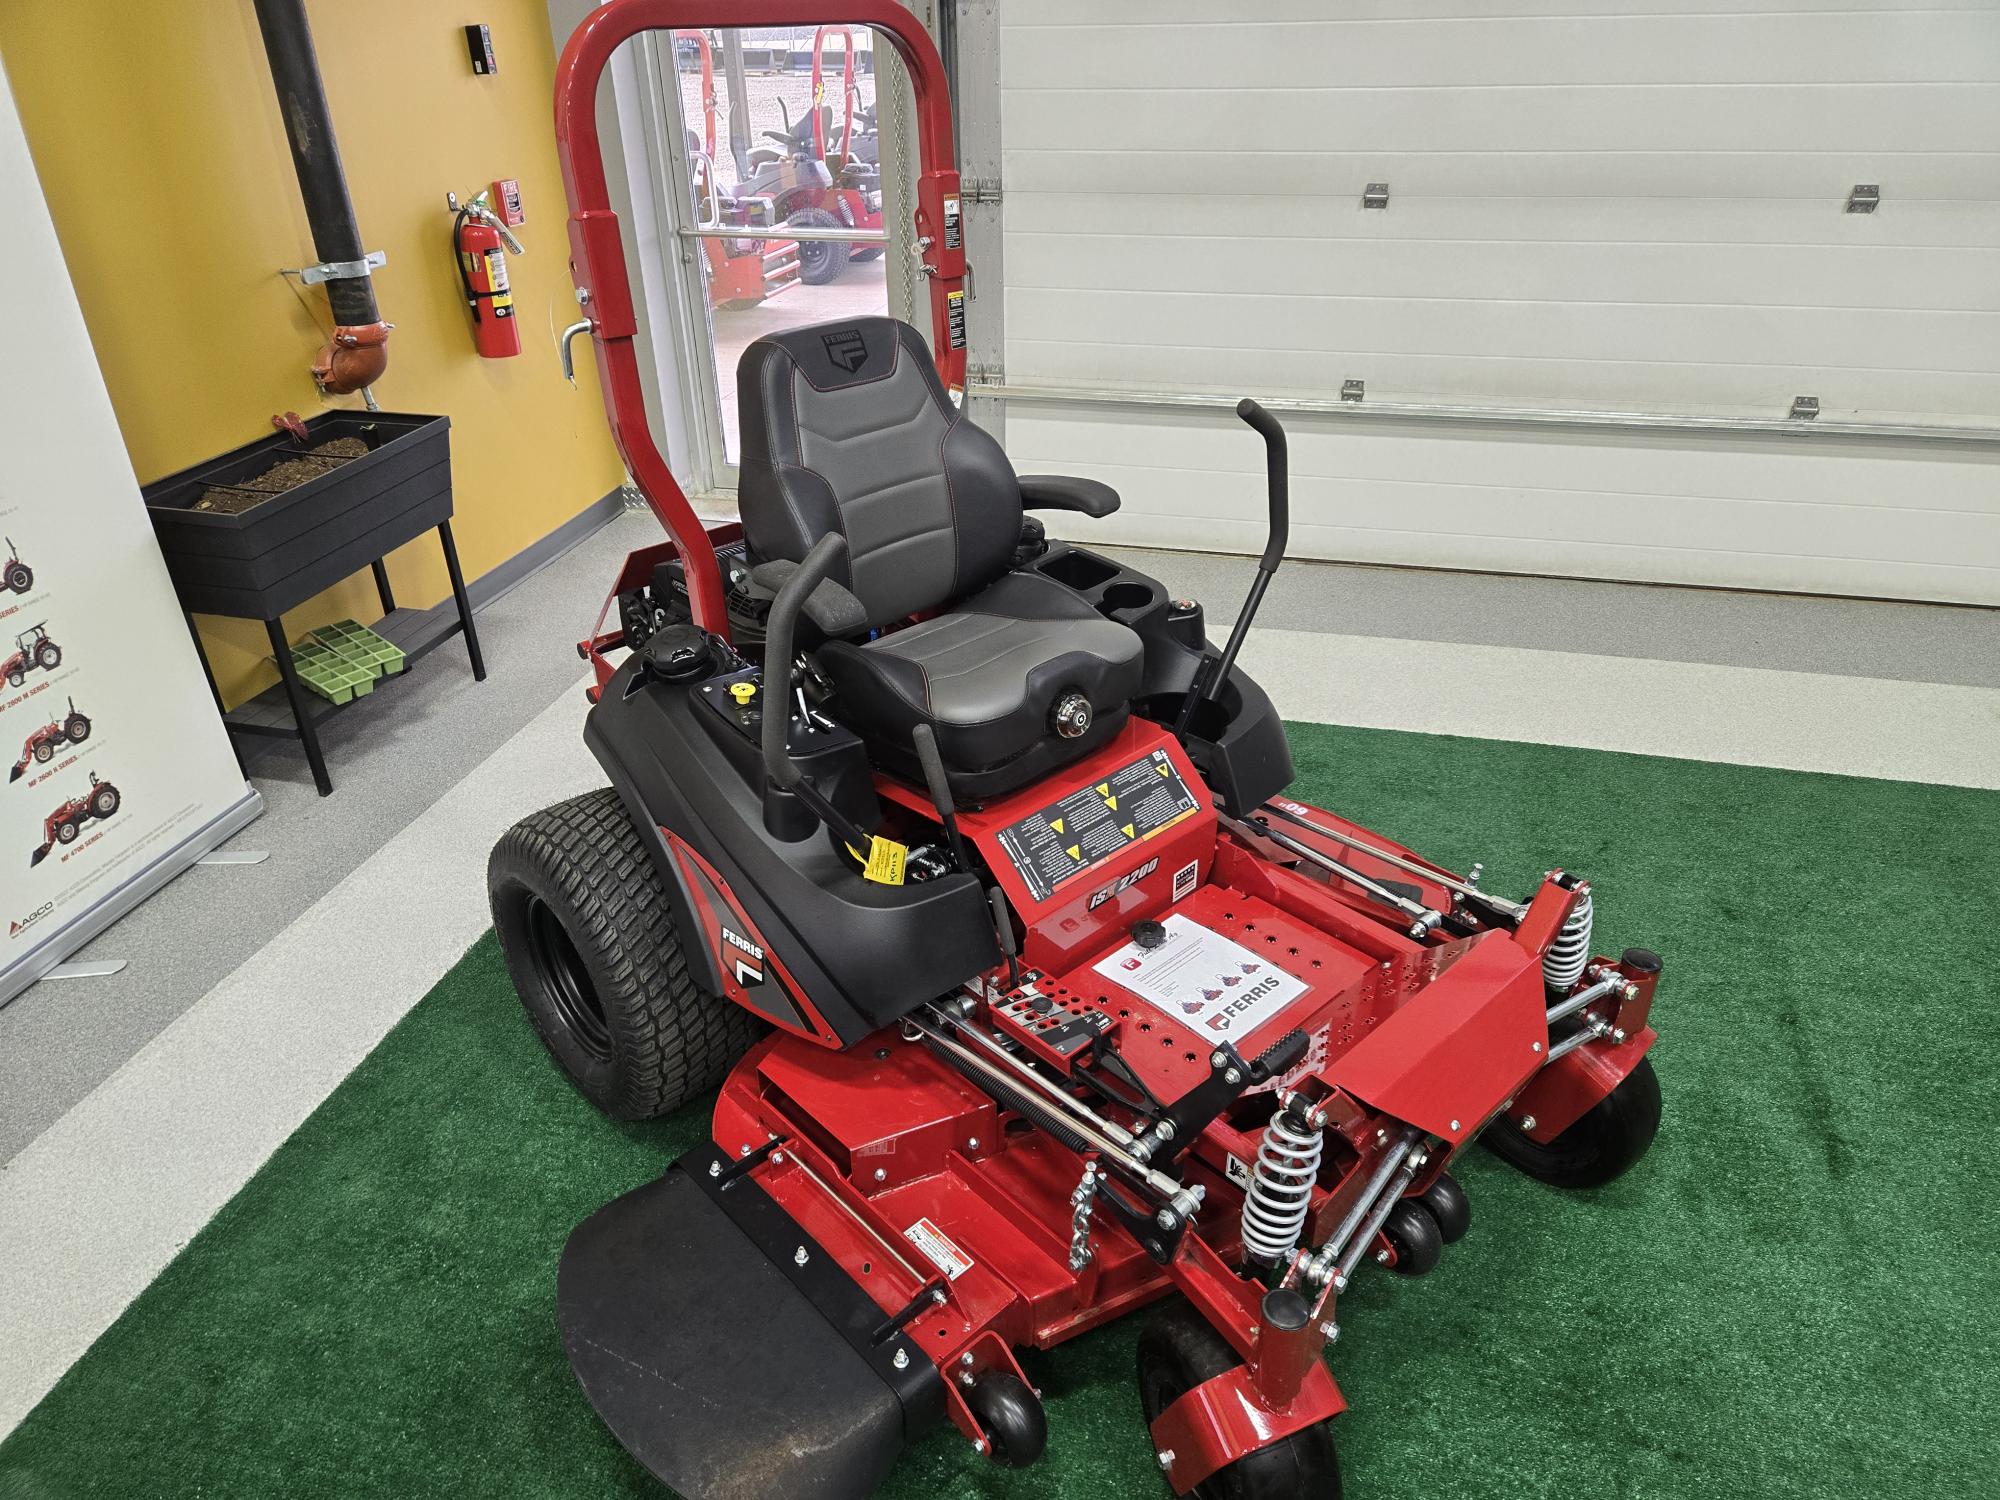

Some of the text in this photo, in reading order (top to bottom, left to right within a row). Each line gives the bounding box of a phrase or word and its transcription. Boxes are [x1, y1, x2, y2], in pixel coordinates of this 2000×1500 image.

[823, 330, 860, 344] FERRIS
[29, 681, 50, 696] SERIES
[28, 778, 38, 788] MF
[58, 754, 78, 769] SERIES
[85, 831, 104, 847] SERIES
[1117, 857, 1159, 892] 2200
[22, 901, 53, 926] AGCO
[722, 928, 762, 959] FERRIS
[1223, 976, 1280, 1018] FERRIS
